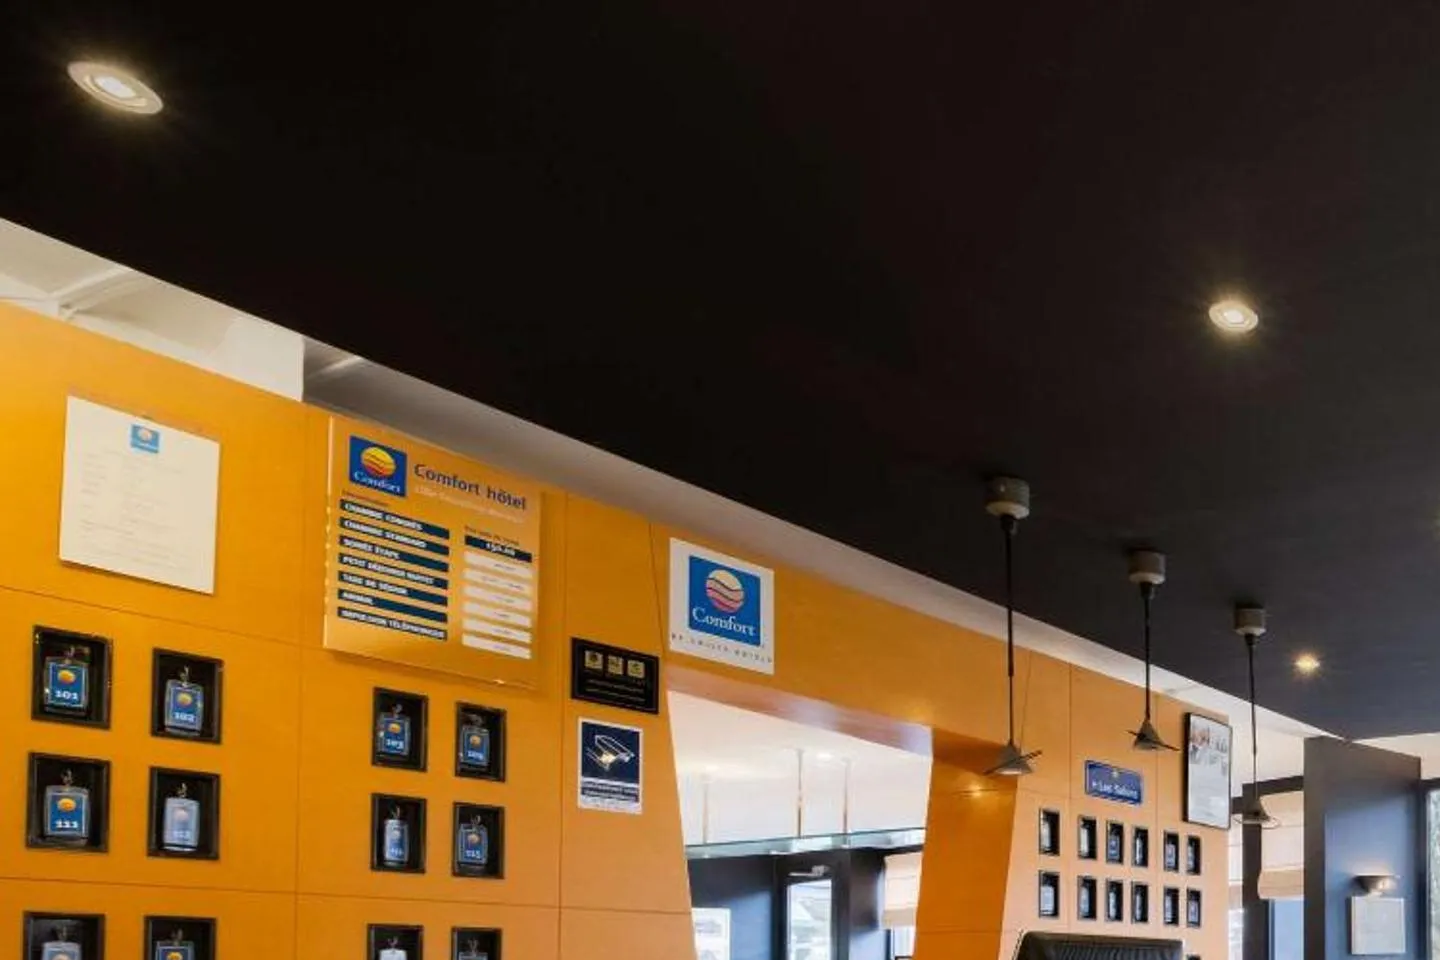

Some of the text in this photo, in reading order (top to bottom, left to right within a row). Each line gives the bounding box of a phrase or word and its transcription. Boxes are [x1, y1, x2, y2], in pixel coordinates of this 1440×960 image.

[354, 471, 401, 493] Comfort
[414, 463, 479, 496] Comfort
[487, 485, 526, 510] hôtel
[692, 606, 757, 636] Comfort
[54, 690, 79, 702] 101
[174, 711, 196, 723] 102
